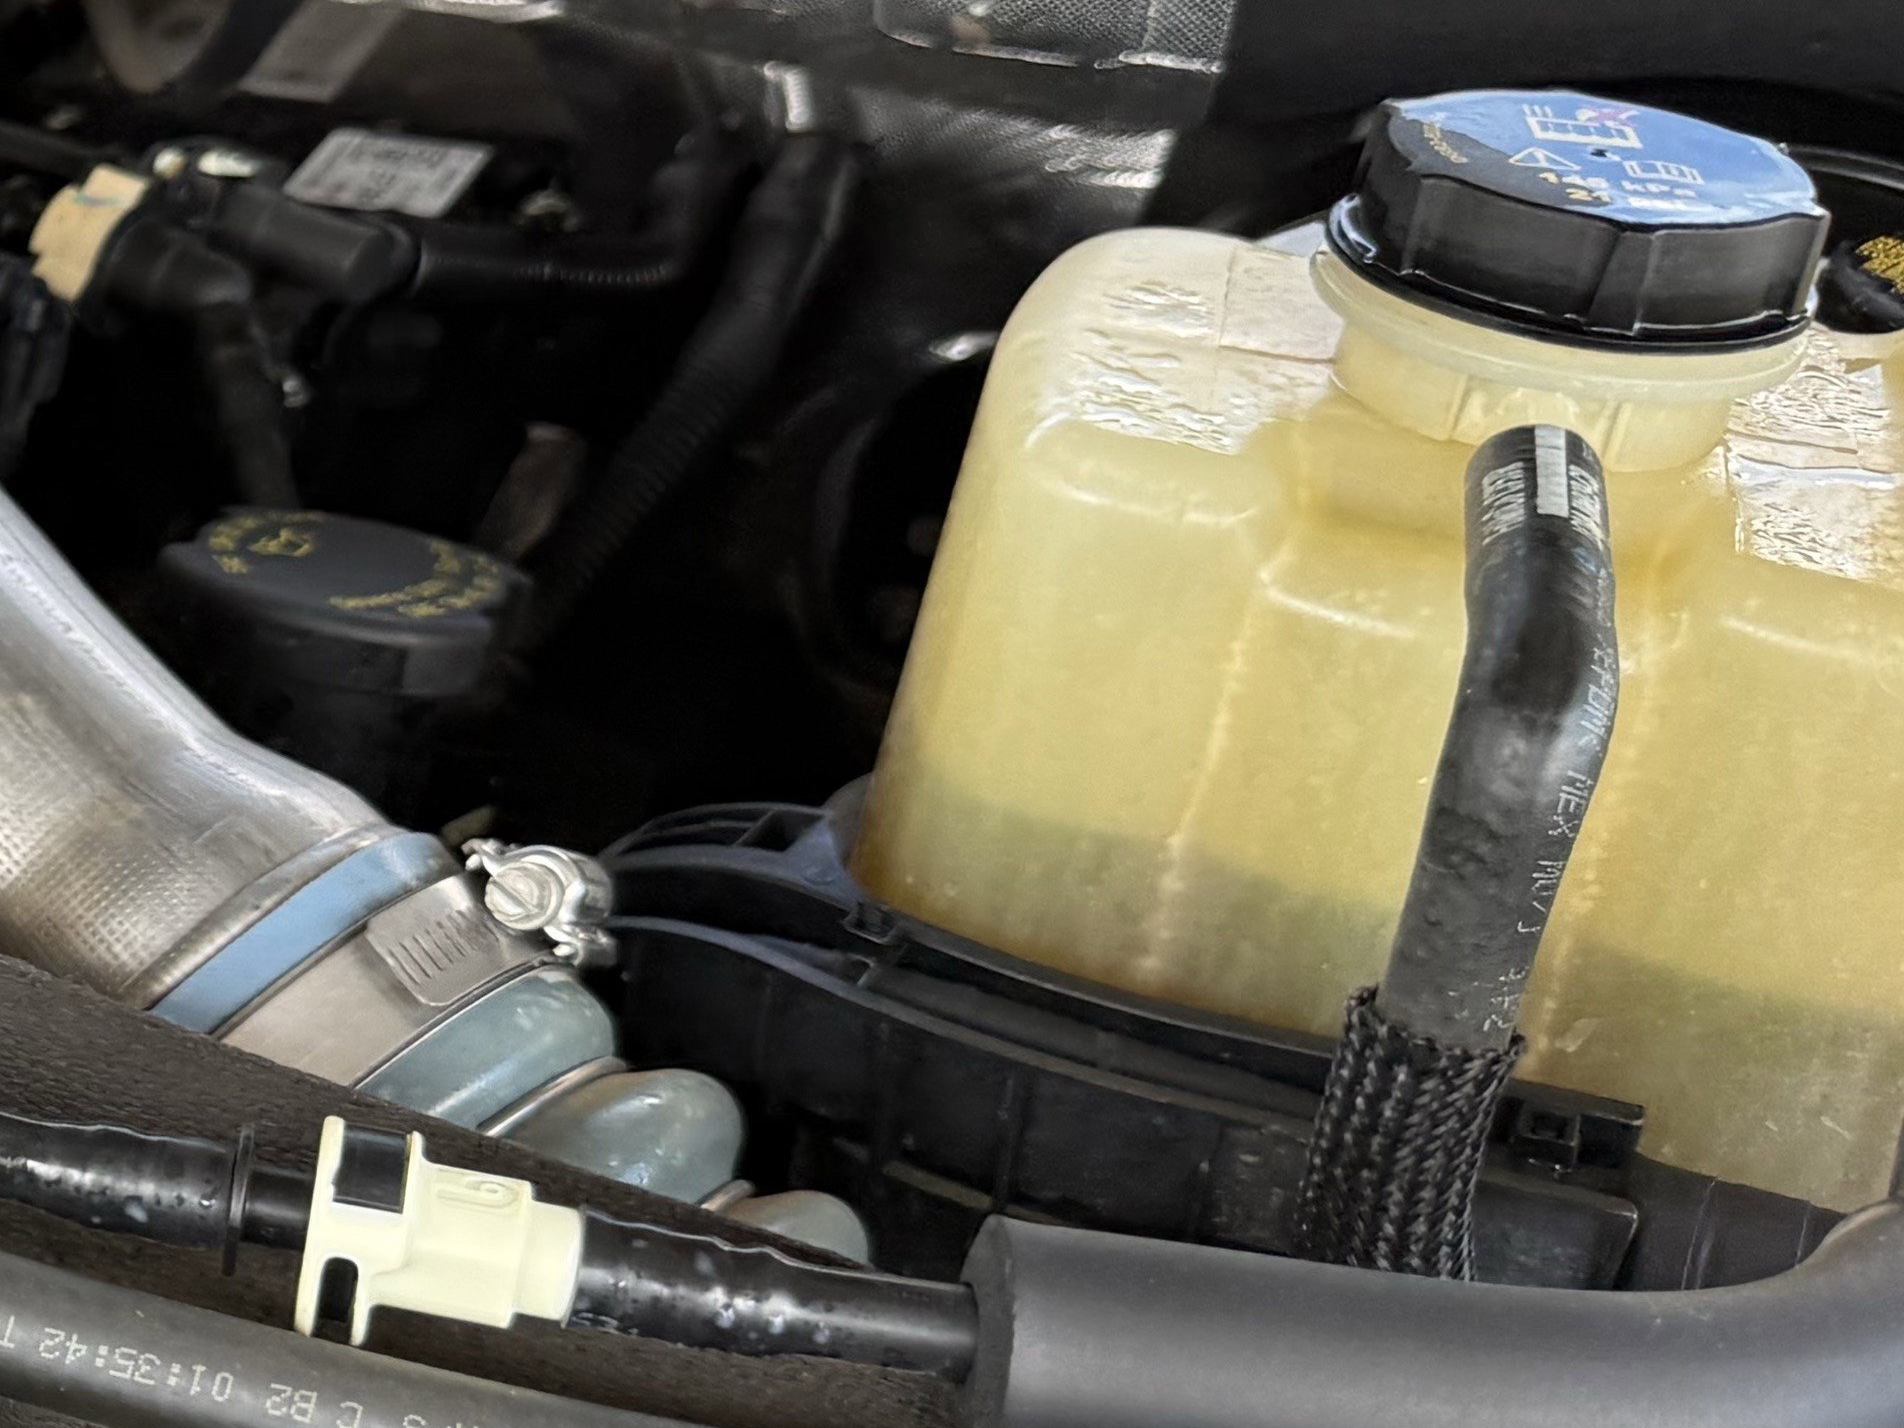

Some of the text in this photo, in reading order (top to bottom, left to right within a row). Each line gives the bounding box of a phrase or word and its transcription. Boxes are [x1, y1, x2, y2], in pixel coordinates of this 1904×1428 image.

[1548, 770, 1594, 838] MEX
[39, 1327, 234, 1403] 01:35:42
[265, 1382, 318, 1424] B2
